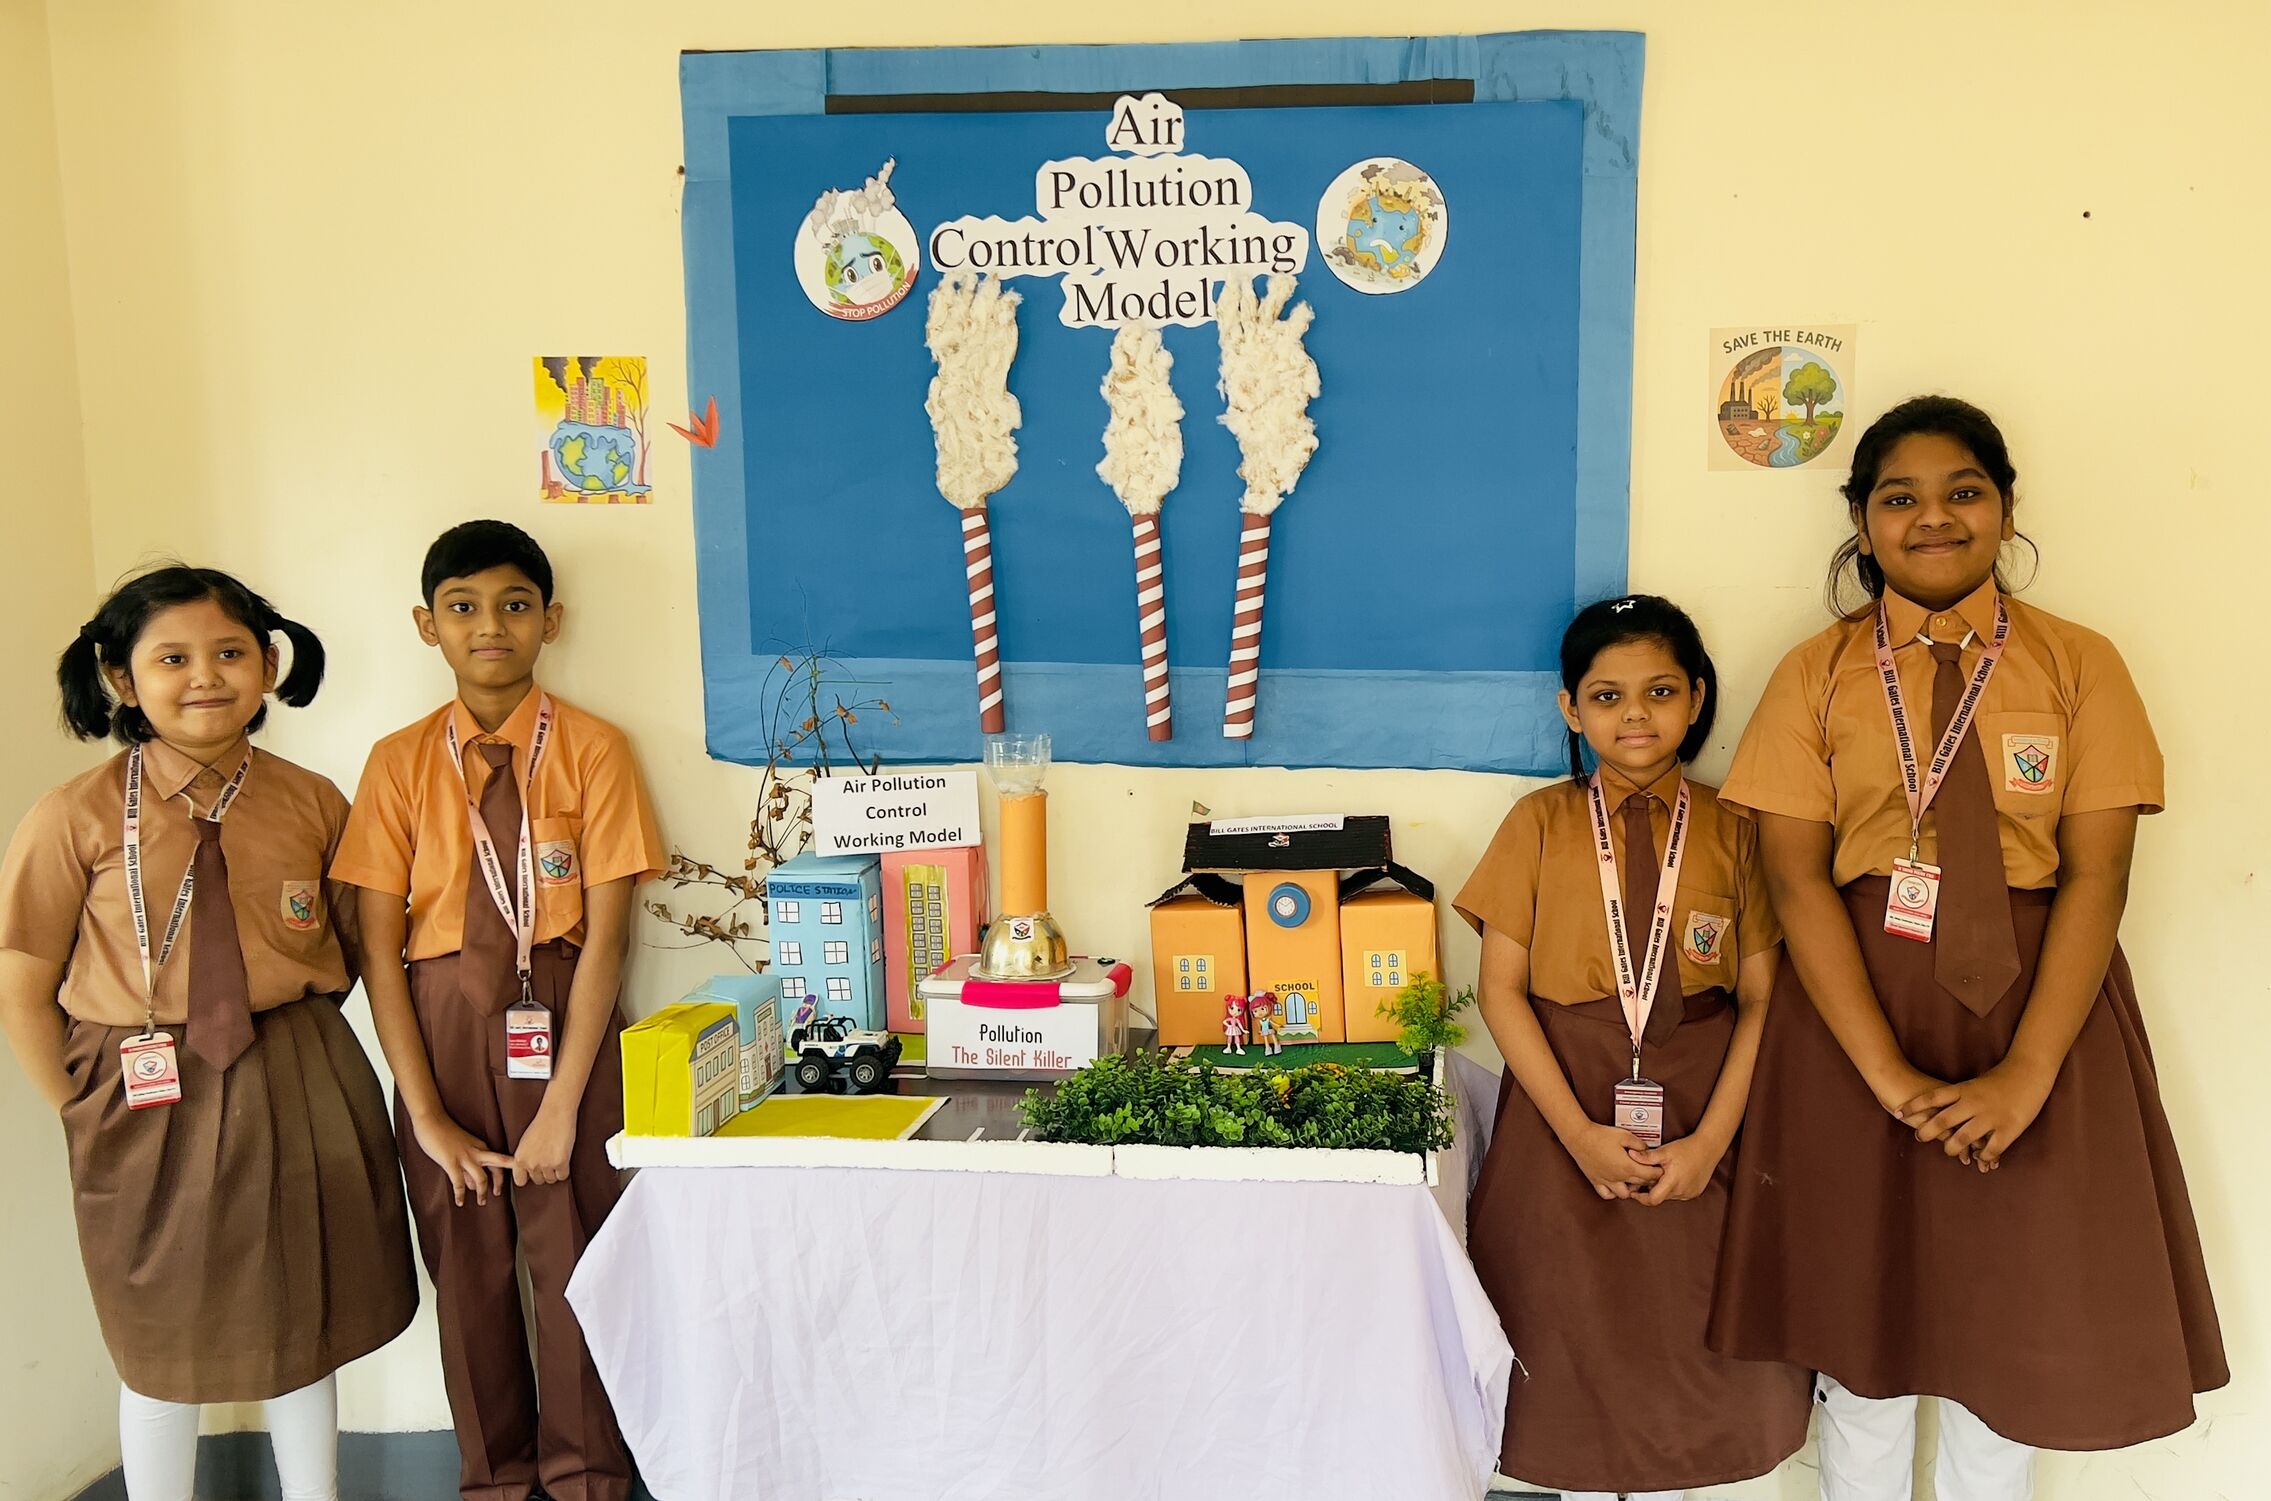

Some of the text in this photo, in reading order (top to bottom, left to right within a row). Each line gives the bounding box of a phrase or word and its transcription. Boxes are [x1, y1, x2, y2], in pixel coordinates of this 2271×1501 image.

[1110, 103, 1182, 146] Air
[1049, 167, 1241, 210] Pollution
[931, 223, 1297, 274] Control Working
[842, 281, 912, 319] STOP POLLUTION
[1073, 277, 1213, 323] Model
[1723, 329, 1843, 354] SAVE THE EARTH
[1994, 625, 2008, 641] Bill
[1931, 657, 1995, 775] Bill Gates International School
[1883, 669, 1918, 793] Bill Gates International School
[842, 775, 946, 794] Air Pollution
[865, 802, 927, 820] Control
[833, 827, 962, 849] Working Model
[1250, 824, 1307, 832] INTERNATIONAL
[127, 843, 138, 866] School
[128, 867, 143, 918] International
[769, 883, 811, 895] POLICE
[1274, 982, 1315, 992] SCHOOL
[700, 1026, 730, 1054] POST OFFICE
[979, 1023, 1043, 1044] Pollution
[952, 1046, 1073, 1068] The Silent Killer
